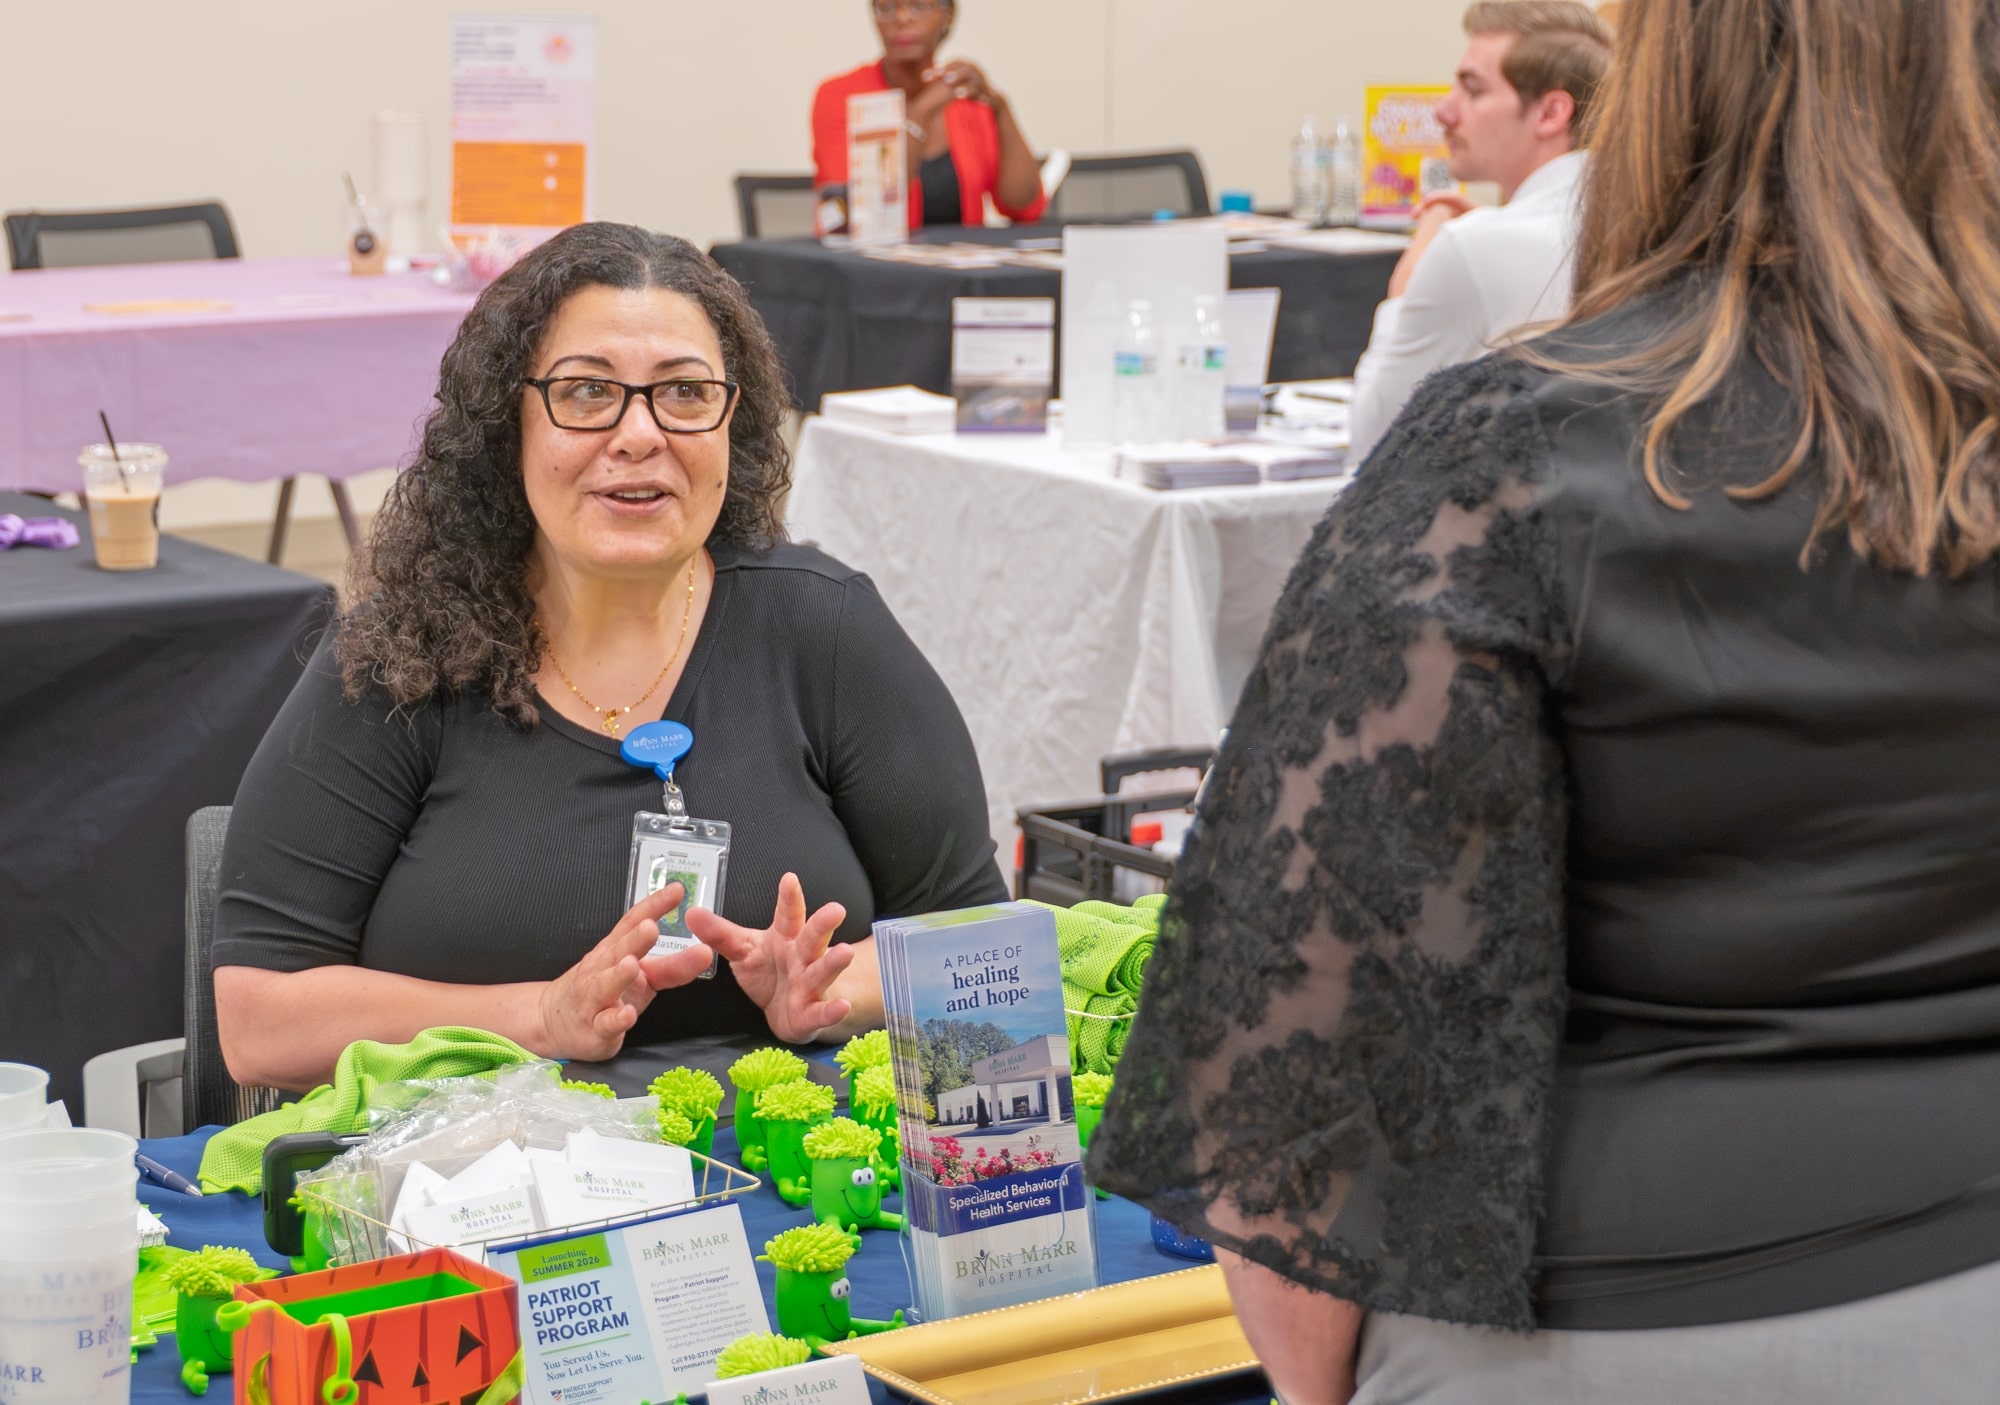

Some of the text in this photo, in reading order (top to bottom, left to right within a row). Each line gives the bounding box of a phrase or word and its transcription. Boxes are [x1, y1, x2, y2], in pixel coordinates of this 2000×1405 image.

[944, 945, 1022, 969] A PLACE OF
[952, 965, 1020, 989] healing
[946, 986, 1030, 1013] and hope
[587, 1186, 633, 1196] HOSPITAL
[612, 1178, 645, 1189] MARR
[949, 1174, 1069, 1210] Specialized Behavioral
[490, 1200, 525, 1215] MARR
[970, 1195, 1051, 1220] Health Services
[466, 1213, 513, 1229] HOSPITAL
[542, 1248, 587, 1263] Launching
[642, 1233, 730, 1260] BRYNN MARR
[532, 1256, 600, 1277] SUMMER 2026
[660, 1250, 715, 1266] HOSPITAL
[955, 1240, 1077, 1279] BRYNN MARR
[684, 1279, 704, 1288] Patriot
[705, 1274, 728, 1284] Support
[978, 1263, 1053, 1287] HOSPITAL
[528, 1280, 600, 1310] PATRIOT
[654, 1294, 680, 1303] Program
[532, 1296, 613, 1327] SUPPORT
[536, 1312, 630, 1346] PROGRAM
[544, 1361, 560, 1370] You
[563, 1352, 593, 1366] Served
[546, 1353, 645, 1382] Now Let Us Serve You.
[672, 1356, 683, 1364] Call
[0, 1363, 46, 1383] ARR
[795, 1378, 838, 1397] MARR
